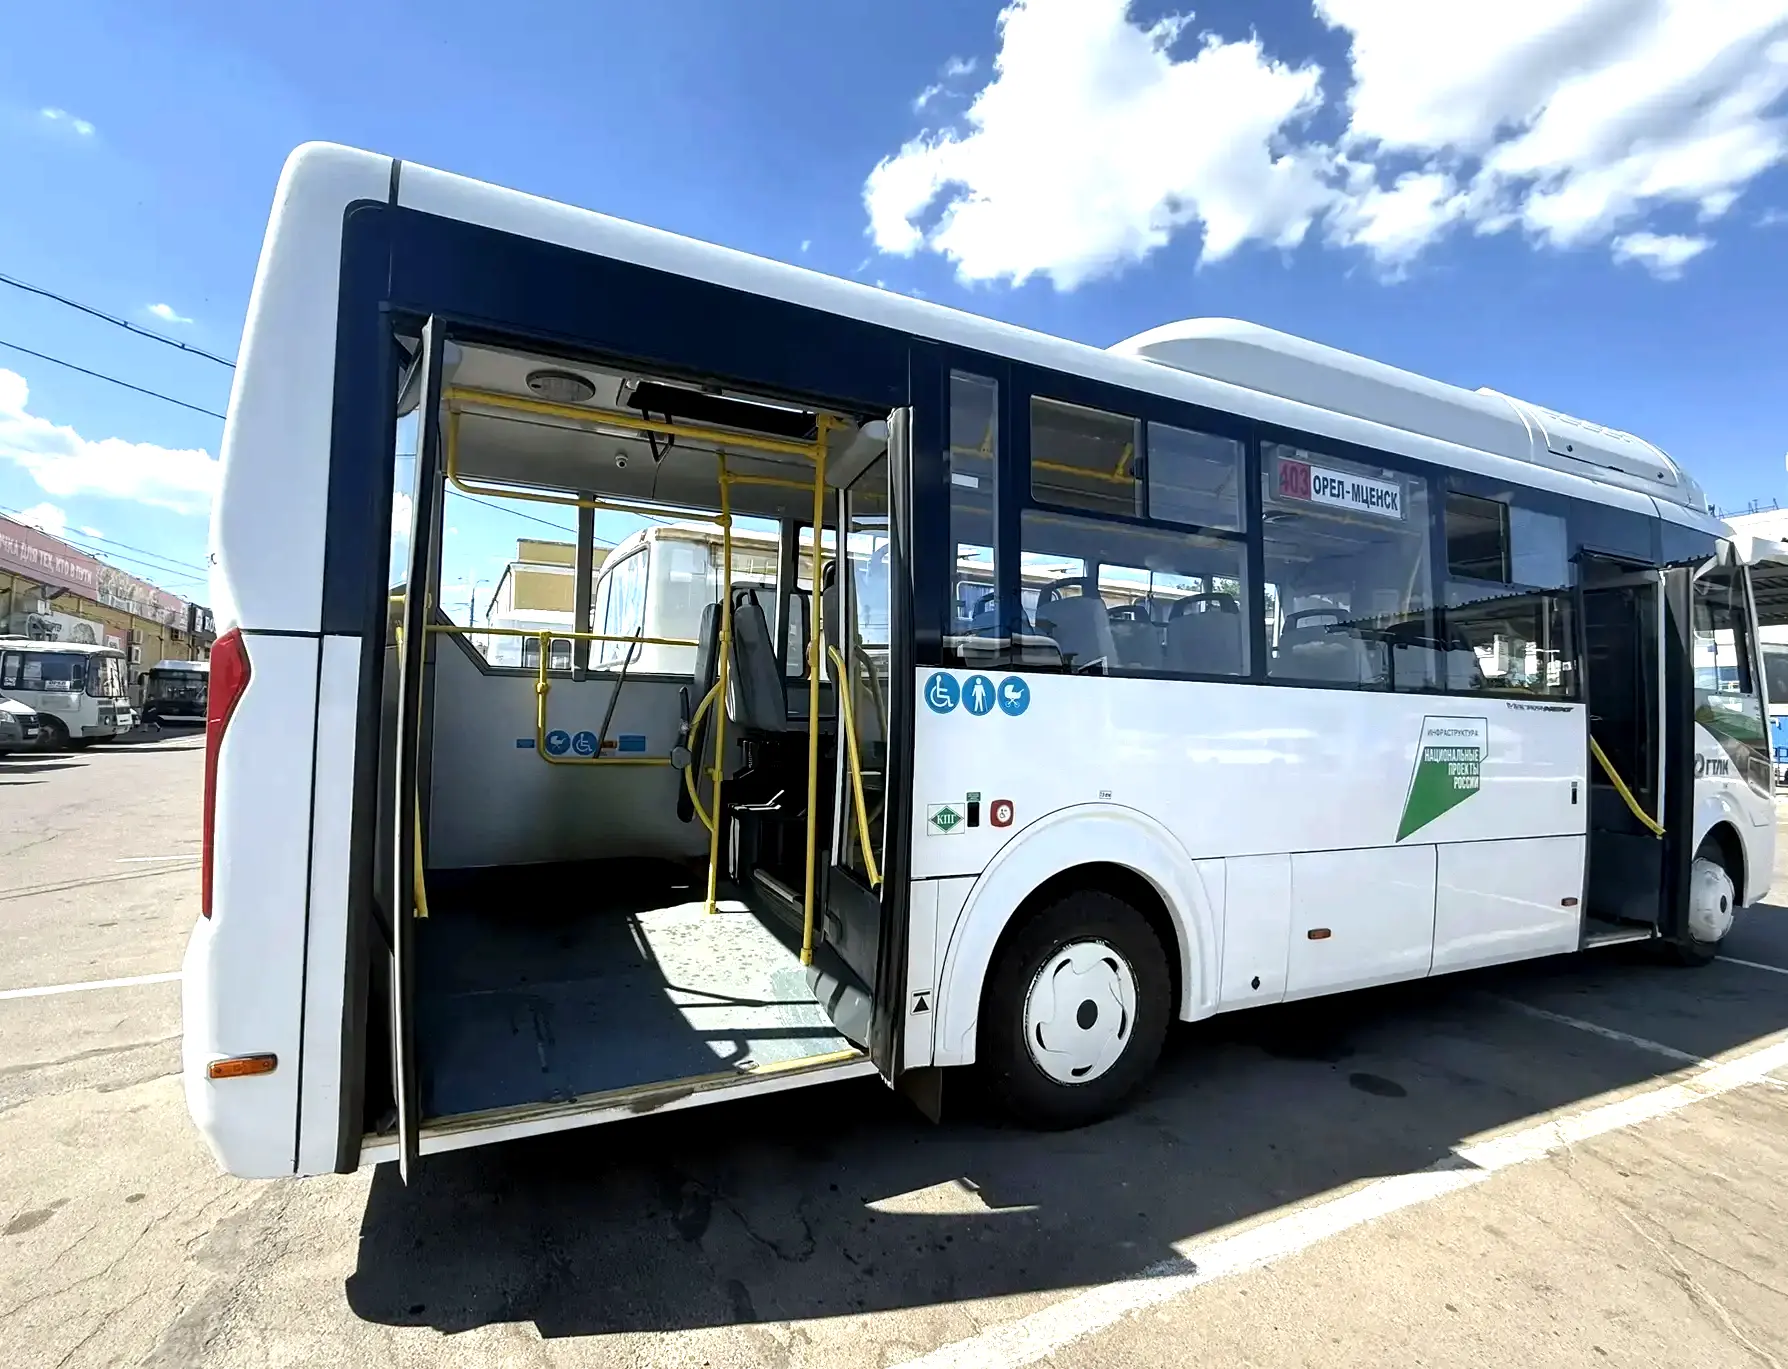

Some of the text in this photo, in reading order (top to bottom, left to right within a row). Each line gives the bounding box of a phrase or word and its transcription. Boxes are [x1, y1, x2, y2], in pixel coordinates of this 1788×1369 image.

[1313, 475, 1398, 511] ОРЕЛ-МЦЕНСК
[20, 542, 38, 564] ДЛЯ
[55, 557, 70, 576] КТО
[75, 565, 93, 585] ПУТИ
[1427, 728, 1479, 737] ИНФРАСТРУКТУРА
[1424, 748, 1480, 763] НАЦИОНАЛЬНЫЕ
[1448, 763, 1480, 776] ПРОЕКТЫ
[1705, 759, 1730, 775] ГТЛК
[1453, 776, 1480, 789] РОССИИ
[936, 813, 956, 826] КПГ
